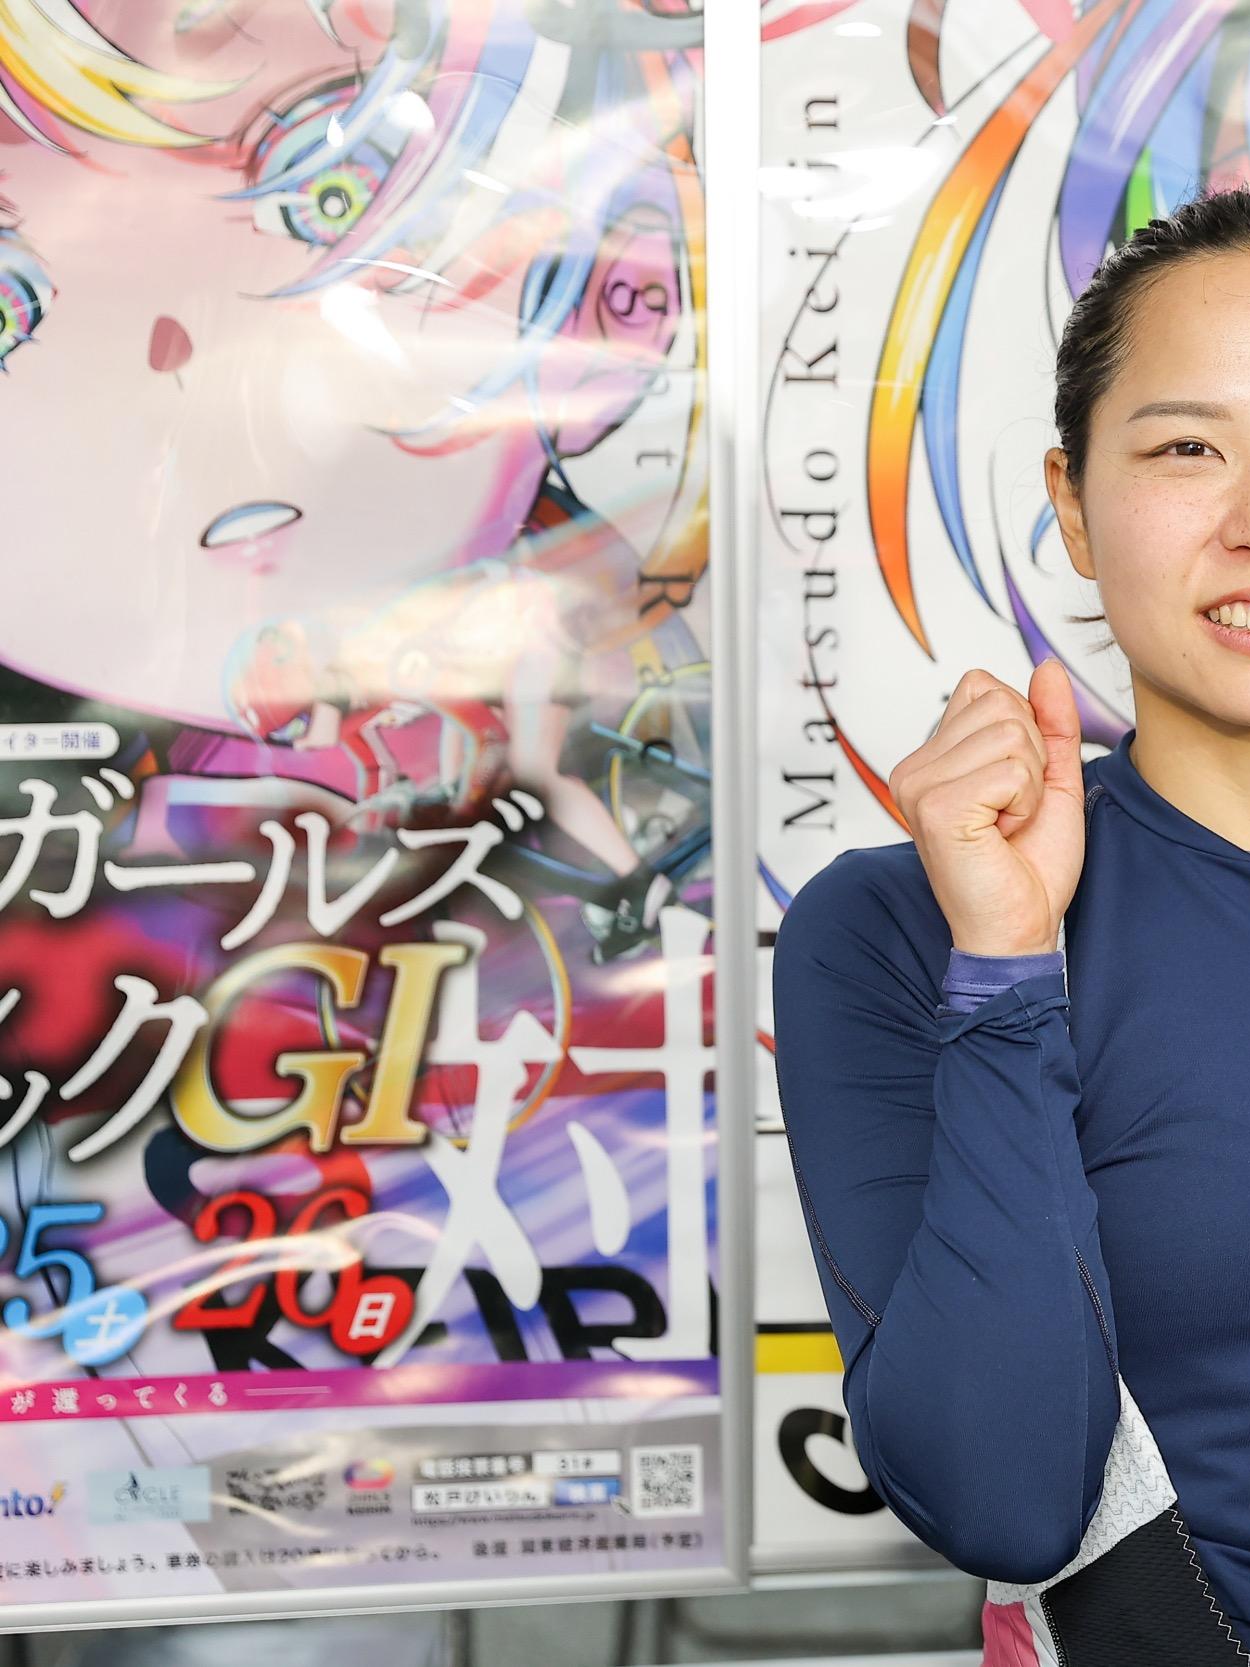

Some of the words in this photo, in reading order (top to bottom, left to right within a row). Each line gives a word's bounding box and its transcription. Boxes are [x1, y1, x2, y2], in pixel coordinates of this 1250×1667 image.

[784, 95, 841, 389] Keiin
[782, 446, 841, 834] Matsudo
[0, 768, 543, 951] ガールズ
[170, 943, 470, 1153] GI
[0, 1203, 105, 1339] 5
[74, 1298, 129, 1350] 土
[171, 1187, 370, 1330] 26
[348, 1291, 397, 1340] 日
